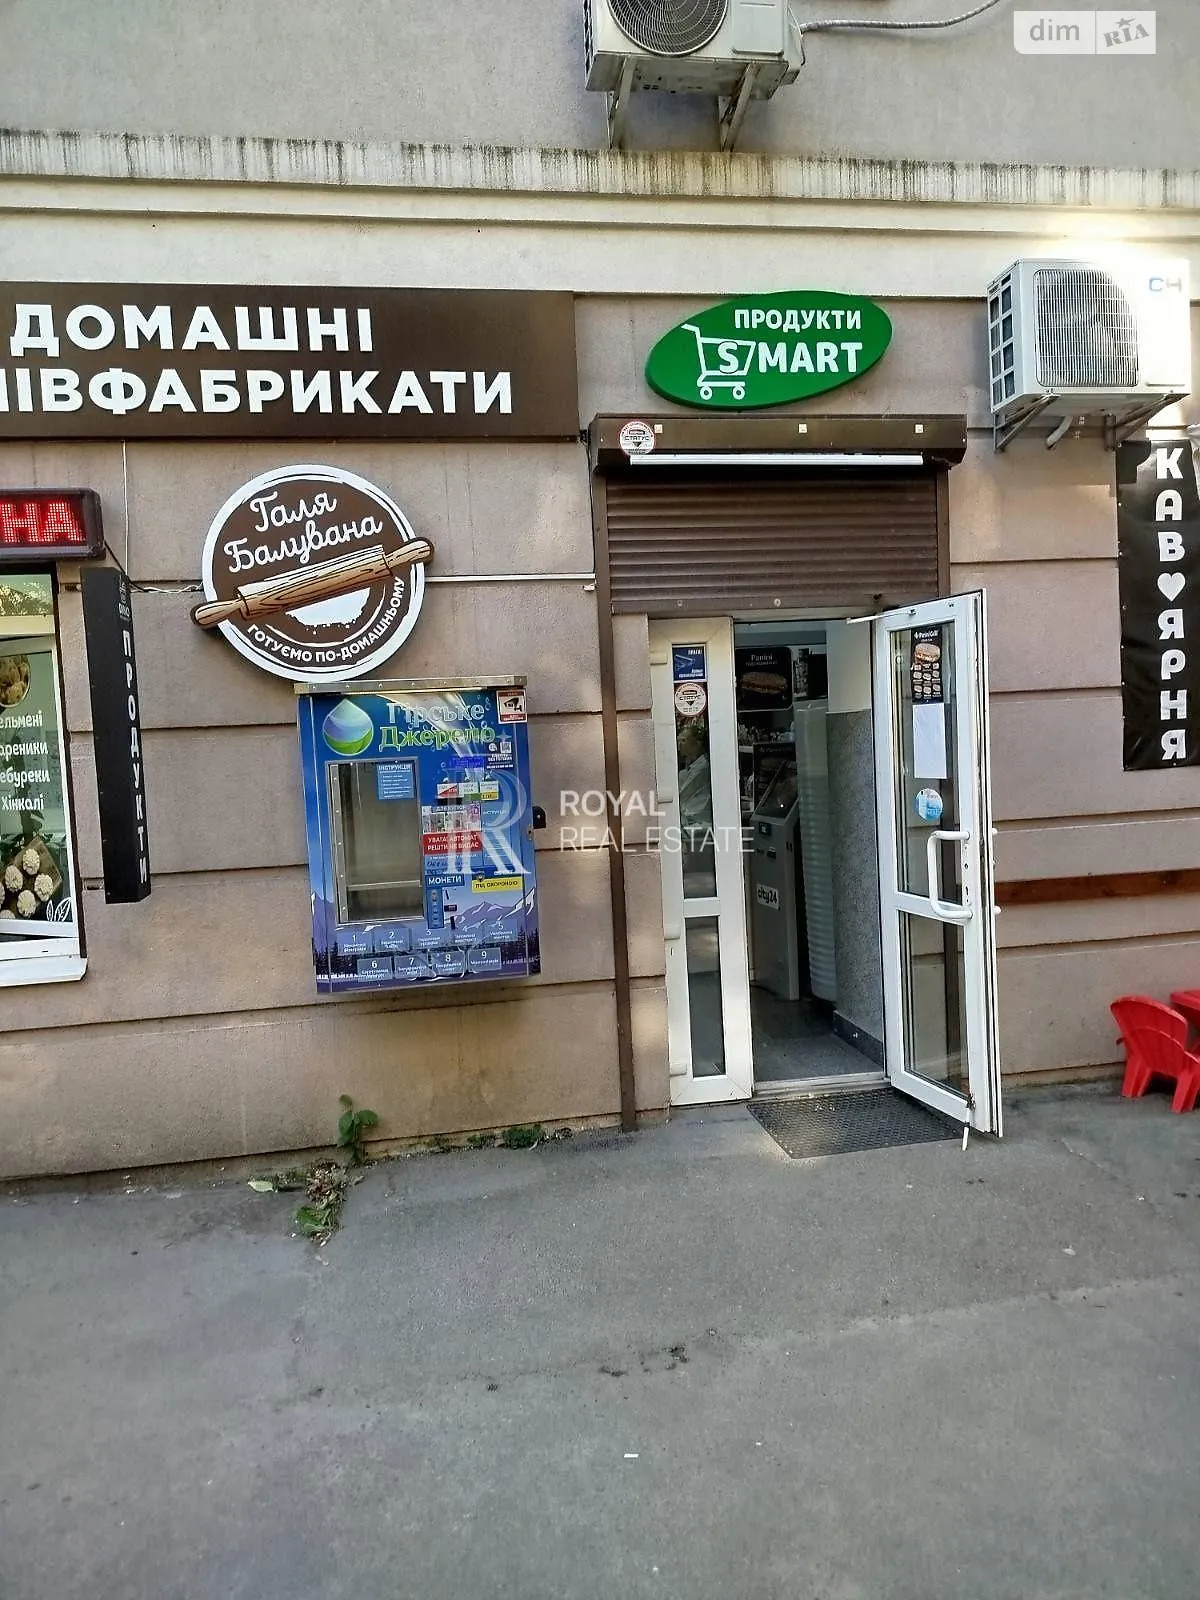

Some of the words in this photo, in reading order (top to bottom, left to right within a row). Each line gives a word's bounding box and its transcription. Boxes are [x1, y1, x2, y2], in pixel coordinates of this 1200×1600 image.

[10, 303, 373, 358] ДОМАШНІ
[734, 308, 862, 333] ПРОДУКТИ
[717, 341, 863, 374] SMART
[0, 366, 512, 415] ІВФАБРИКАТИ
[249, 490, 338, 532] Галя
[223, 515, 384, 574] Балувана
[247, 623, 313, 663] ГОТУЄМО
[315, 576, 406, 664] ПО-ДОМАШНЬОМУ
[386, 702, 485, 727] Гірське
[121, 629, 148, 885] ПРОДУКТИ
[378, 726, 496, 752] Джерело
[428, 875, 462, 885] МОНЕТИ
